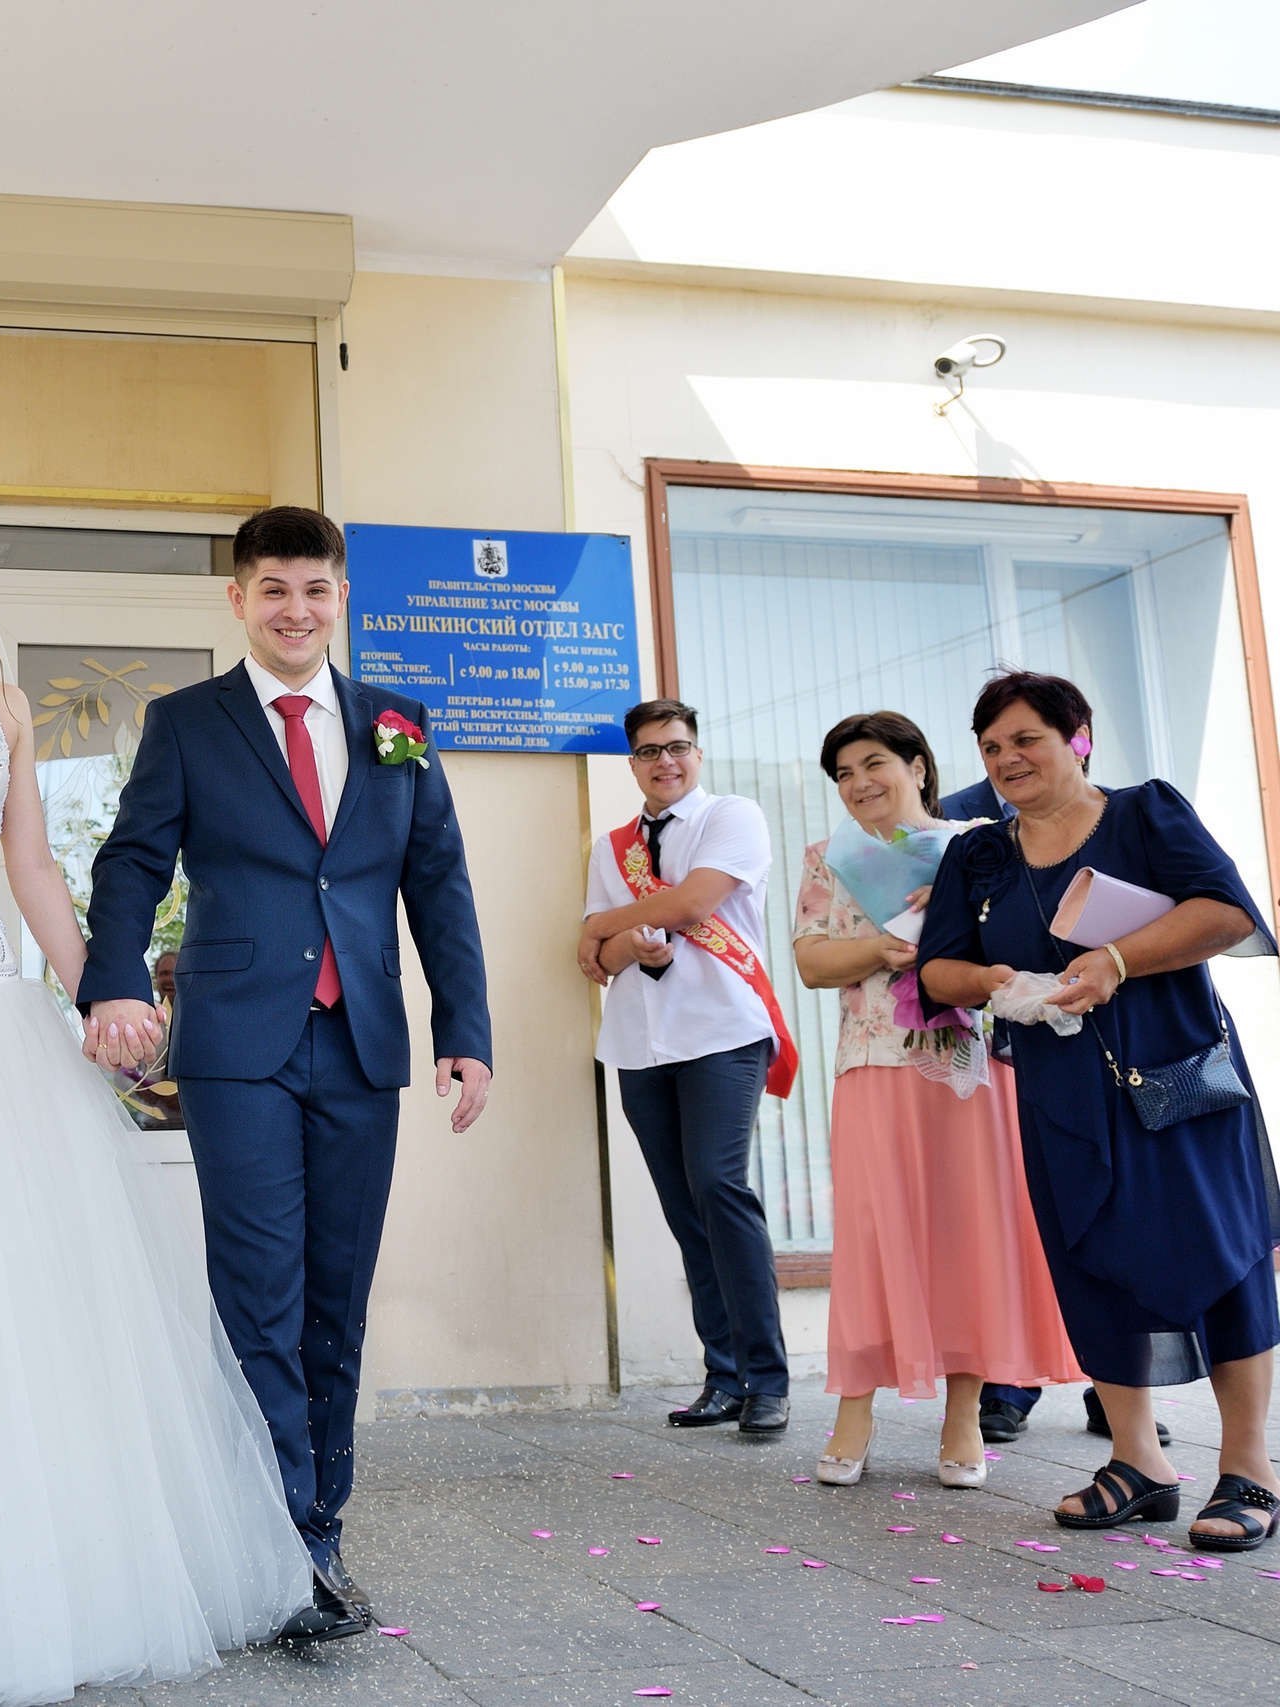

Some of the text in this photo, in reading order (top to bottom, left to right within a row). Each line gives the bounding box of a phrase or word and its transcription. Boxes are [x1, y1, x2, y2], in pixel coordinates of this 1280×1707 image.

[428, 580, 556, 595] ПРАВИТЕЛЬСТВО МОСКВЫ
[406, 595, 579, 613] УПРАВЛЕНИЕ ЗАГС МОСКВЫ
[362, 614, 625, 640] БАБУШКИНСКИЙ ОТДЕЛ ЗАГС
[463, 642, 531, 653] ЧАСЫ РАБОТЫ:
[553, 646, 618, 656] ЧАСЫ ПРИЕМА
[360, 652, 403, 662] ВТОРНИК,
[360, 663, 432, 674] СРЕДА, ЧЕТВЕРГ,
[460, 666, 540, 680] с 9.00 до 18.00
[553, 662, 629, 675] с 9.00 до 13.30
[361, 674, 447, 685] ПЯТНИЦА, СУББОТА
[554, 677, 630, 690] с 15.00 до 17.30
[447, 696, 493, 706] ПЕРЕРЫВ
[501, 698, 522, 707] 14.00
[523, 700, 533, 708] до
[534, 699, 555, 708] 15.00
[444, 709, 469, 720] ДНИ:
[471, 710, 543, 721] ВОСКРЕСЕНЬЕ,
[544, 712, 615, 723] ПОНЕДЕЛЬНИК
[431, 720, 460, 731] РТЫЙ
[461, 722, 504, 732] ЧЕТВЕРГ
[506, 724, 553, 735] КАЖДОГО
[555, 725, 595, 736] МЕСЯЦА
[454, 735, 550, 747] САНИТАРНЫЙ ДЕНЬ
